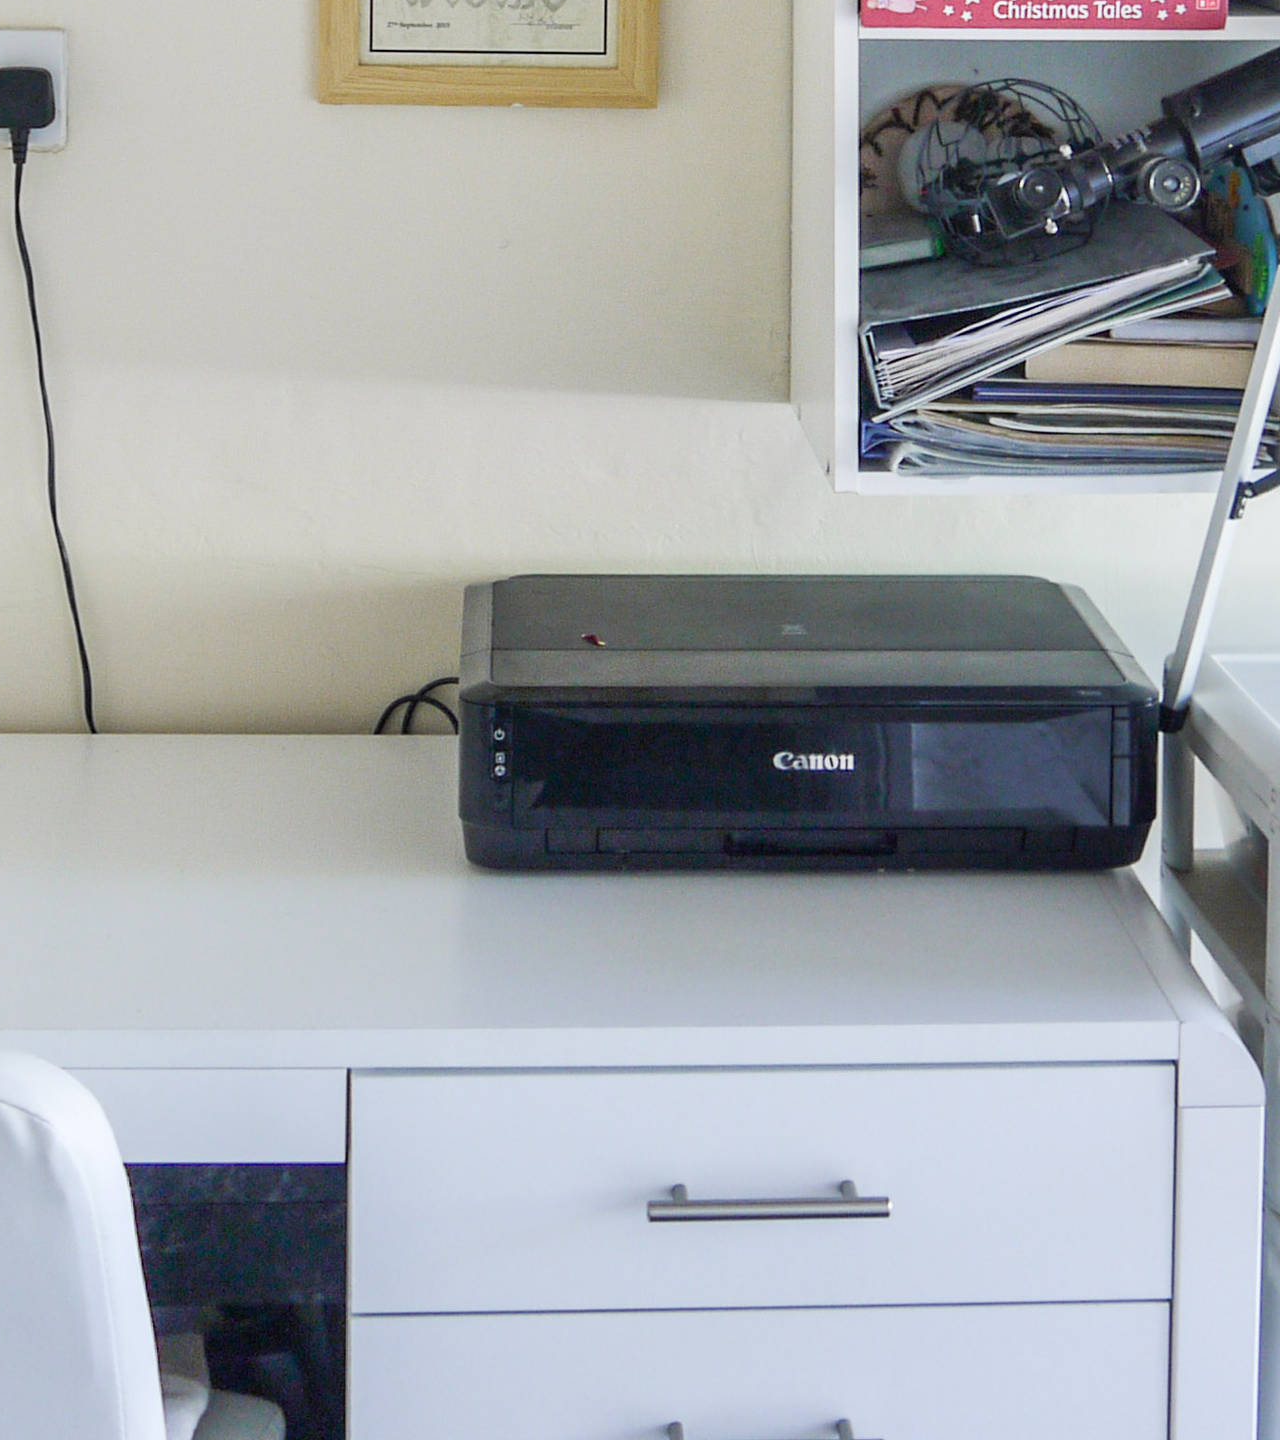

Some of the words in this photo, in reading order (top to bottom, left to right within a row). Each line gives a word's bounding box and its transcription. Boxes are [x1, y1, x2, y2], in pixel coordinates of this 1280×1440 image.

[992, 0, 1089, 20] Christmas
[1091, 1, 1143, 20] Tales
[772, 750, 855, 772] Canon
